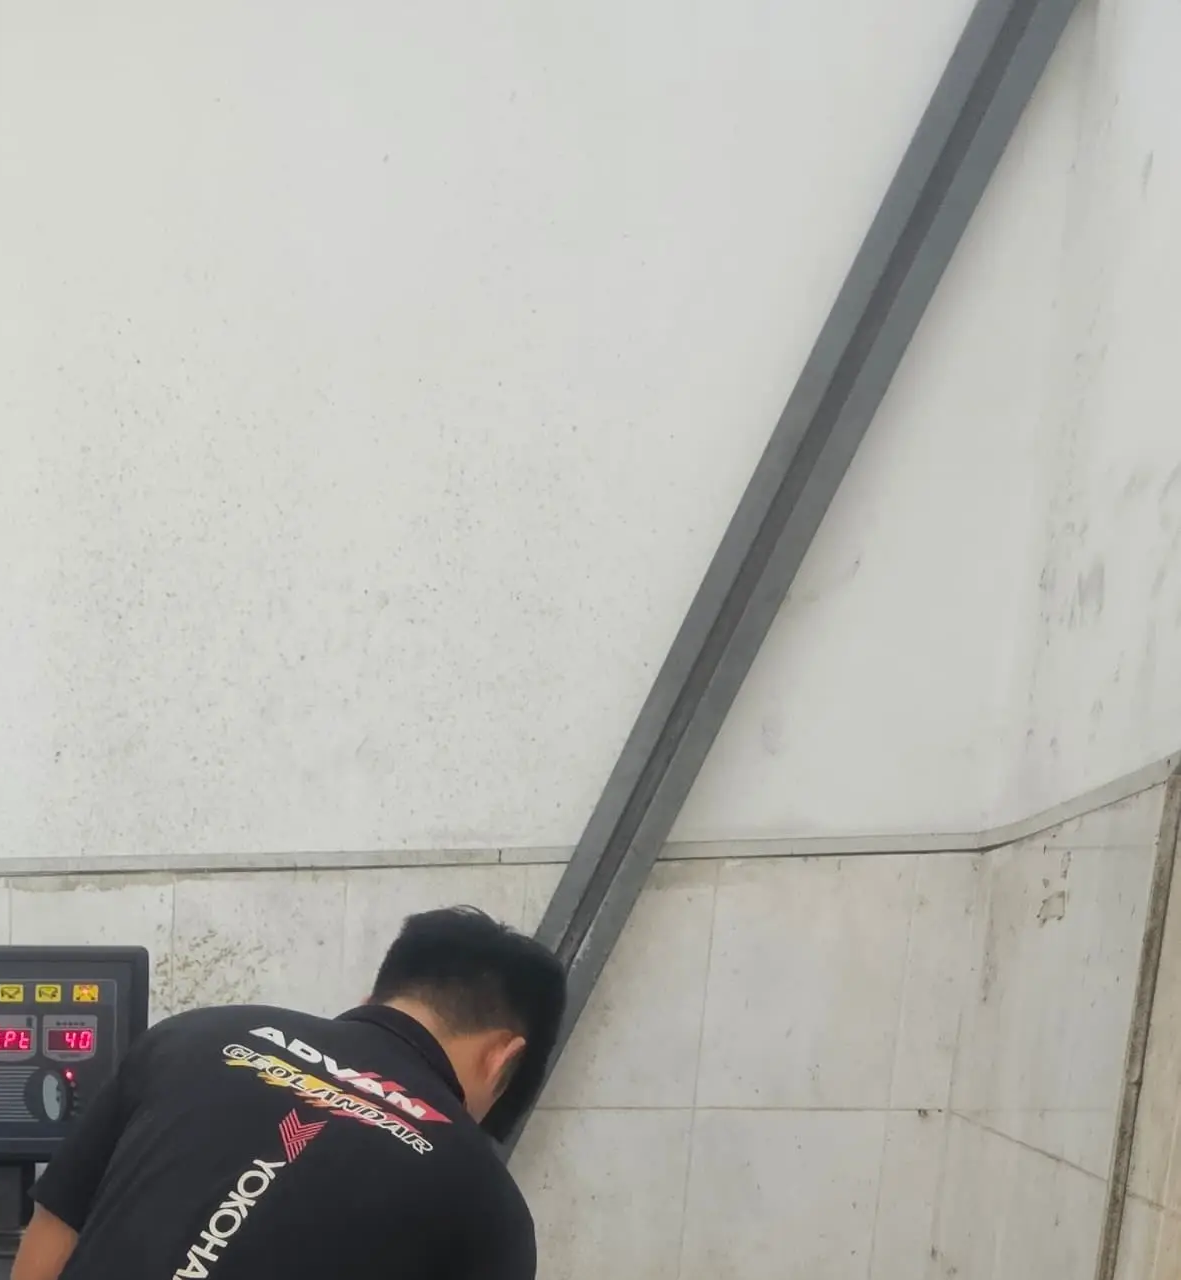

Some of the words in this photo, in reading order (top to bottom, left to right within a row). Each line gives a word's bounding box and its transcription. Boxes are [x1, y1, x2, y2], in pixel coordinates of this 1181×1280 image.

[65, 1031, 92, 1048] 40
[249, 1027, 427, 1119] ADVAN
[223, 1044, 434, 1154] GEOLANDAR
